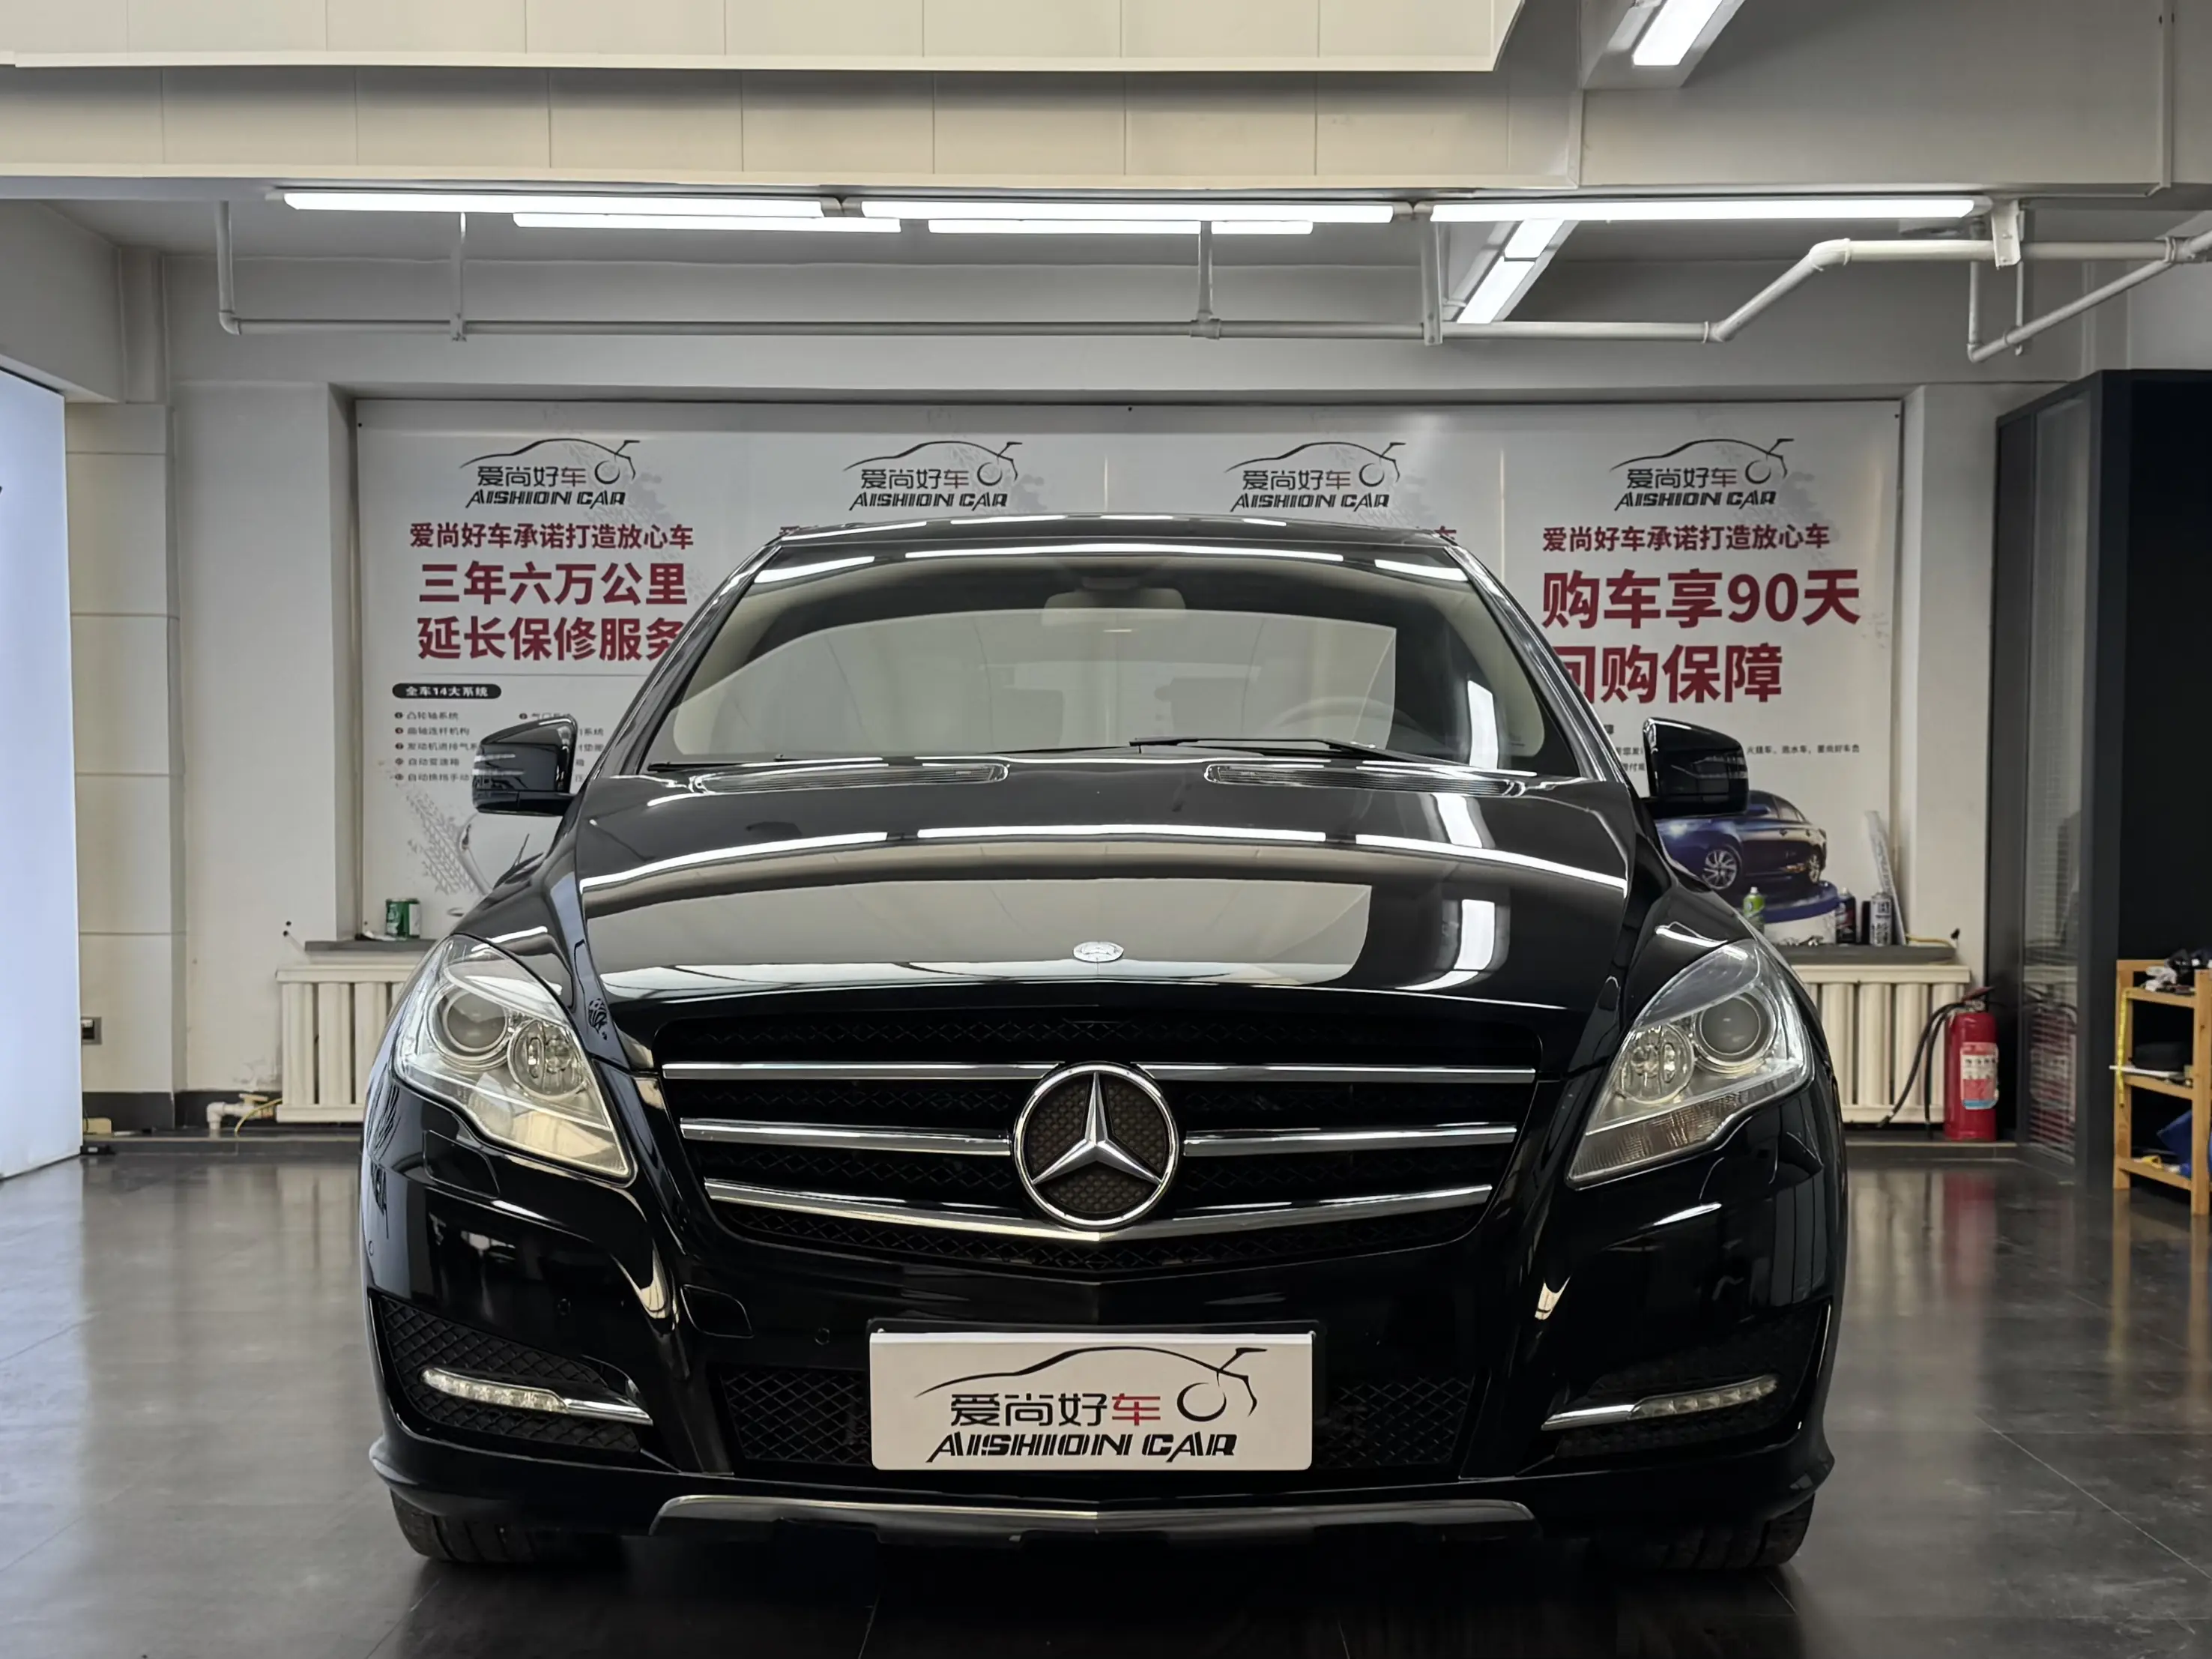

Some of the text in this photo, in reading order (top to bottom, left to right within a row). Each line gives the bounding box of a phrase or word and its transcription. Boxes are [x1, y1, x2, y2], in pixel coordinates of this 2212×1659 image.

[477, 465, 587, 488] 爱尚好车
[859, 468, 970, 490] 爱尚好车
[1242, 468, 1351, 491] 爱尚好车
[1627, 467, 1738, 489] 爱尚好车
[465, 489, 626, 510] AISHION CAR
[848, 492, 1008, 512] AISHION CAR
[1230, 492, 1390, 513] AISHION CAR
[1614, 489, 1777, 511] AISHION CAR
[410, 522, 694, 551] 爱尚好车承诺打造放心车
[1542, 525, 1830, 552] 爱尚好车承诺打造放心车
[419, 560, 688, 605] 三年六万公里
[1542, 568, 1861, 629] 购车享90天
[417, 616, 686, 661] 延长保修服务
[405, 686, 489, 697] 全车14大系统
[949, 1392, 1161, 1427] 爱尚好车
[926, 1430, 1238, 1463] AISHION CAR
